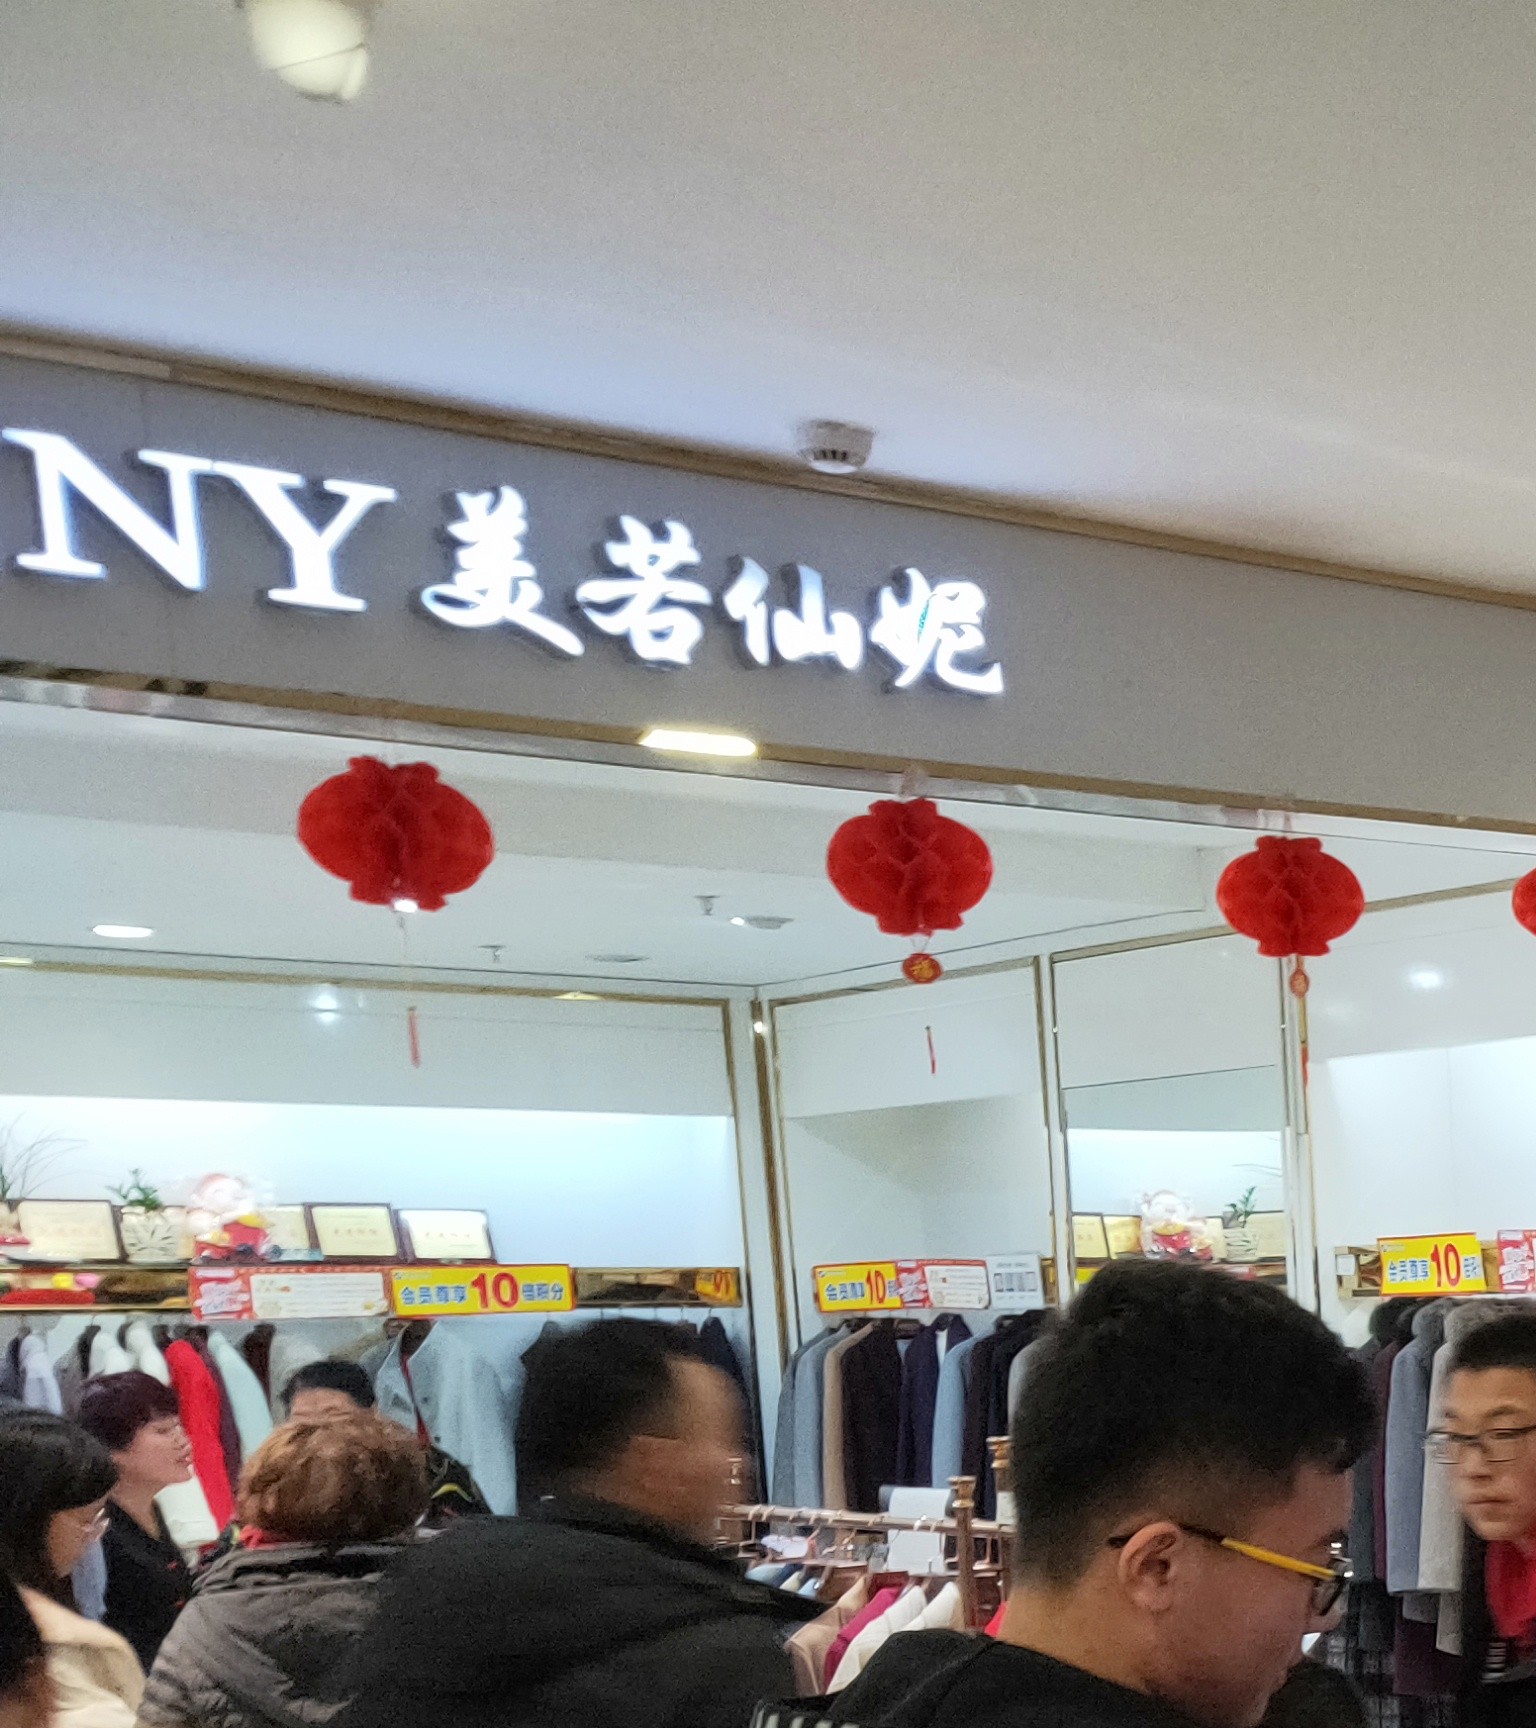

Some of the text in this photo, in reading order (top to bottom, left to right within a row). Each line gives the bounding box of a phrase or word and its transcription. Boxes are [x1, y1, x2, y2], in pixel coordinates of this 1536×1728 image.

[1, 427, 1005, 695] NY 美若仙妮
